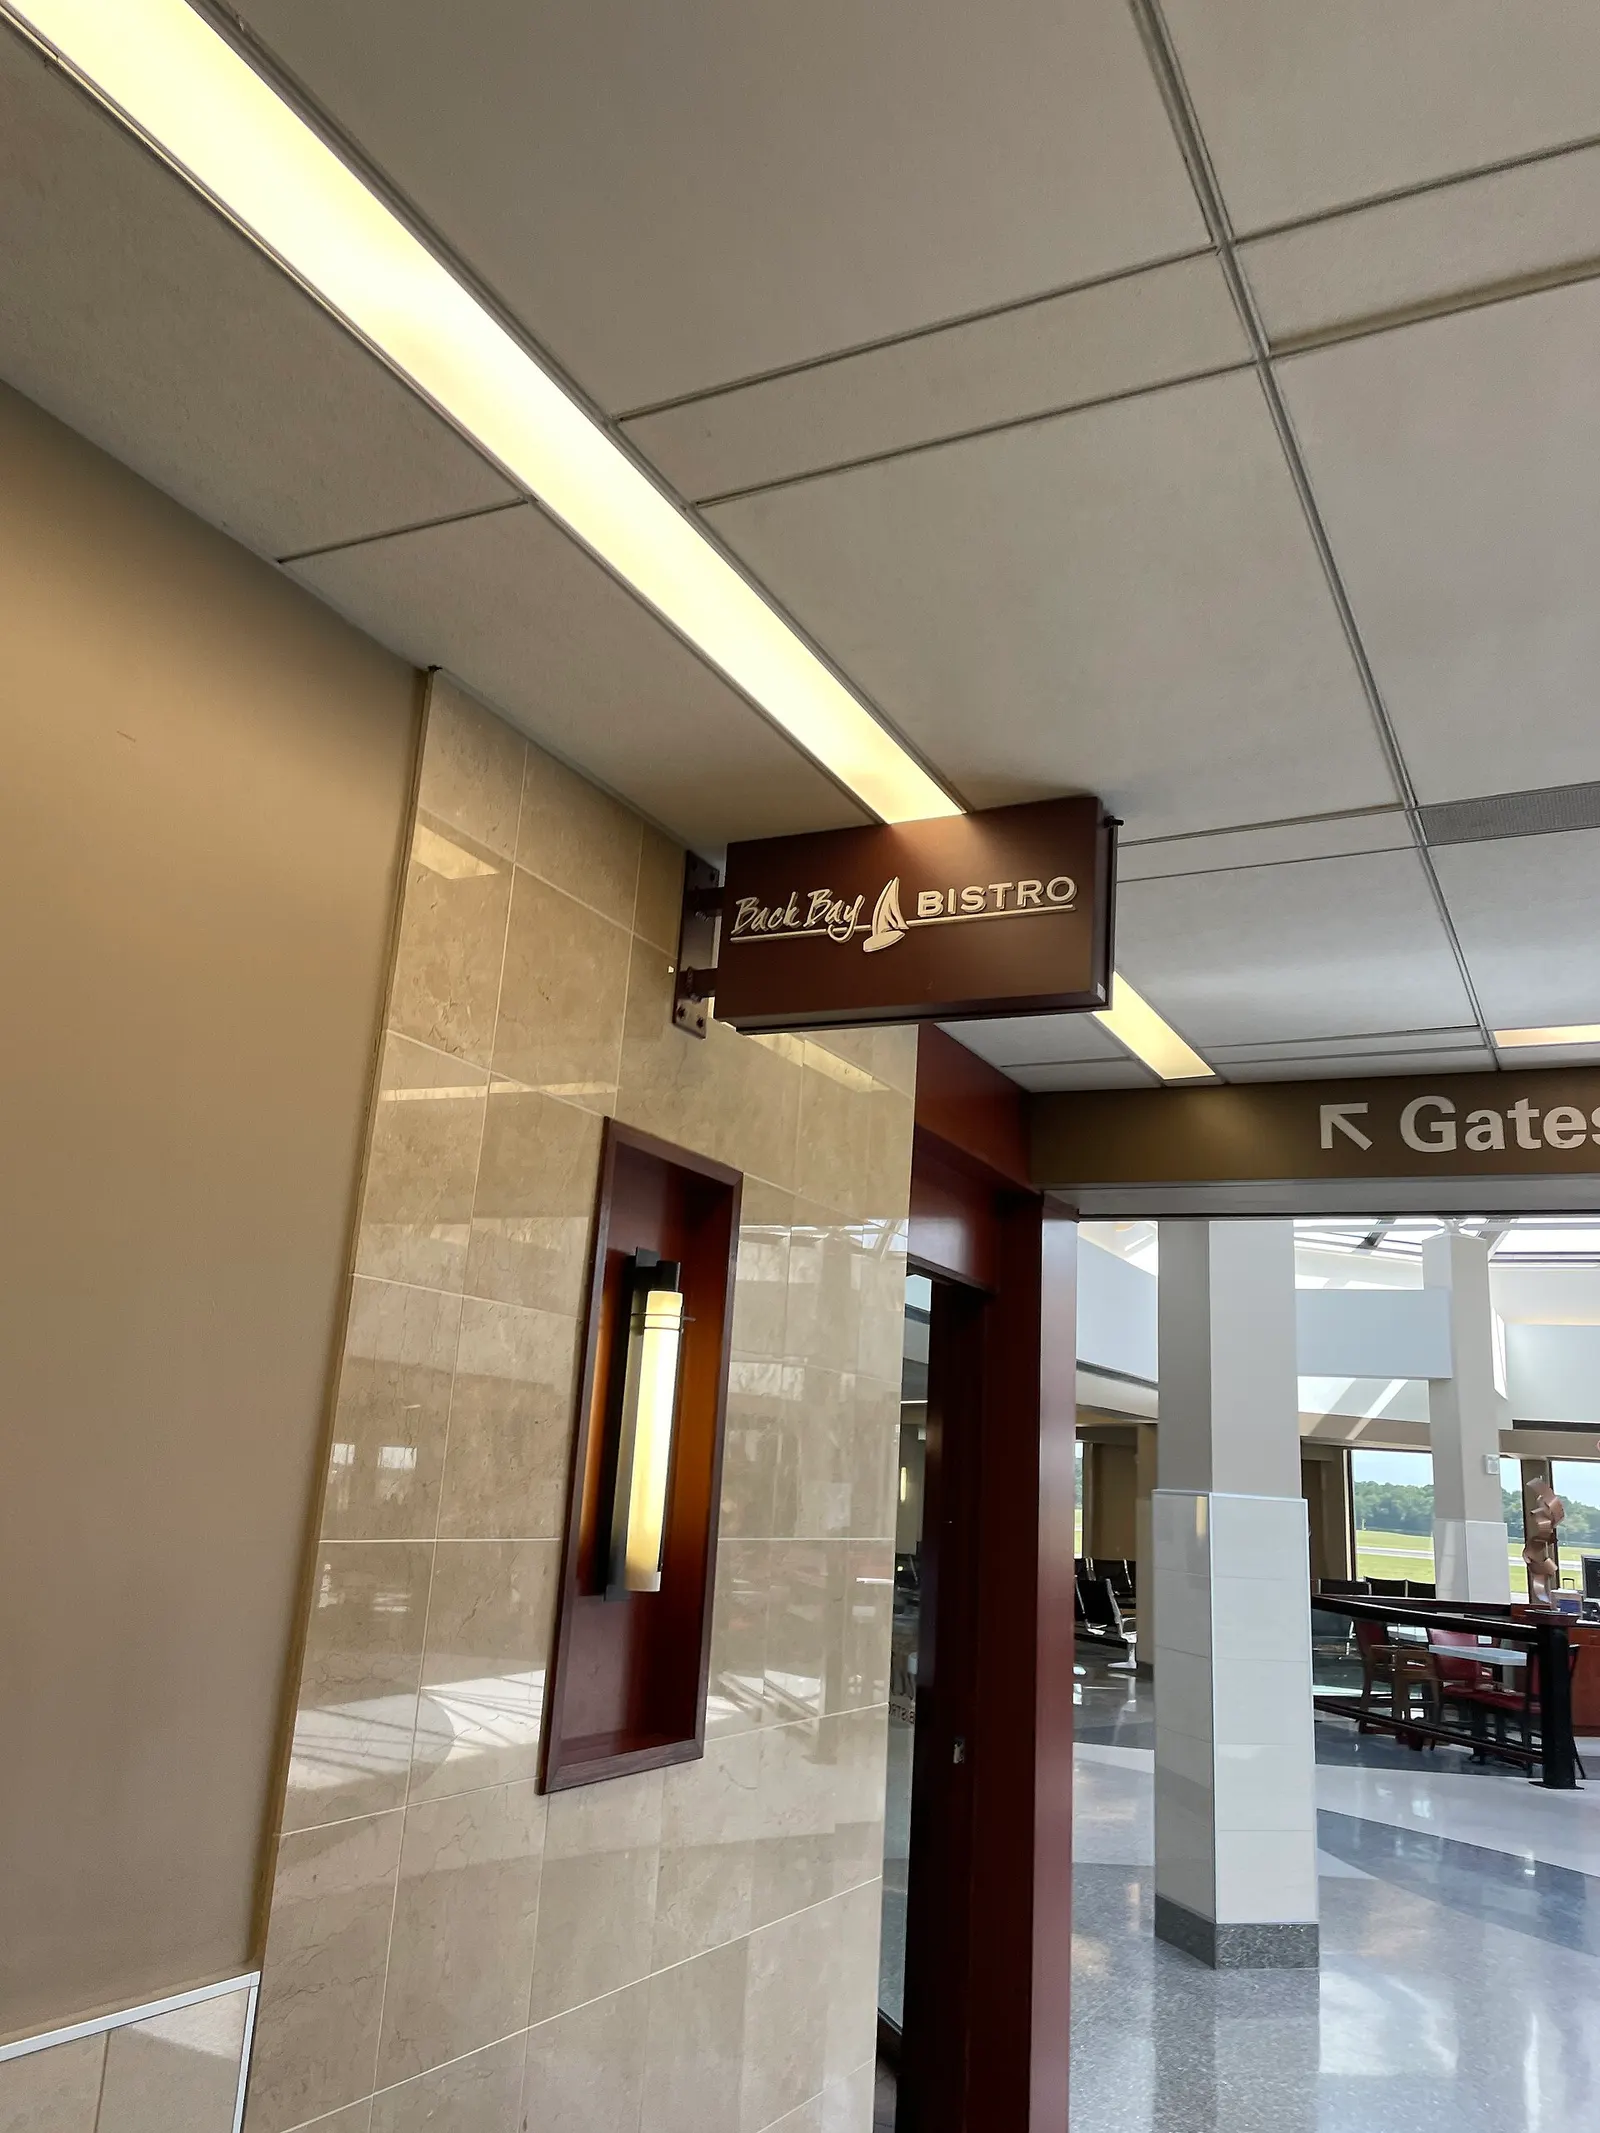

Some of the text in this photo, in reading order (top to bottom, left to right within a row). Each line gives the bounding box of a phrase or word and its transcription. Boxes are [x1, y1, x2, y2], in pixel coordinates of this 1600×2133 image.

[731, 876, 1077, 943] Back Bay BISTRO
